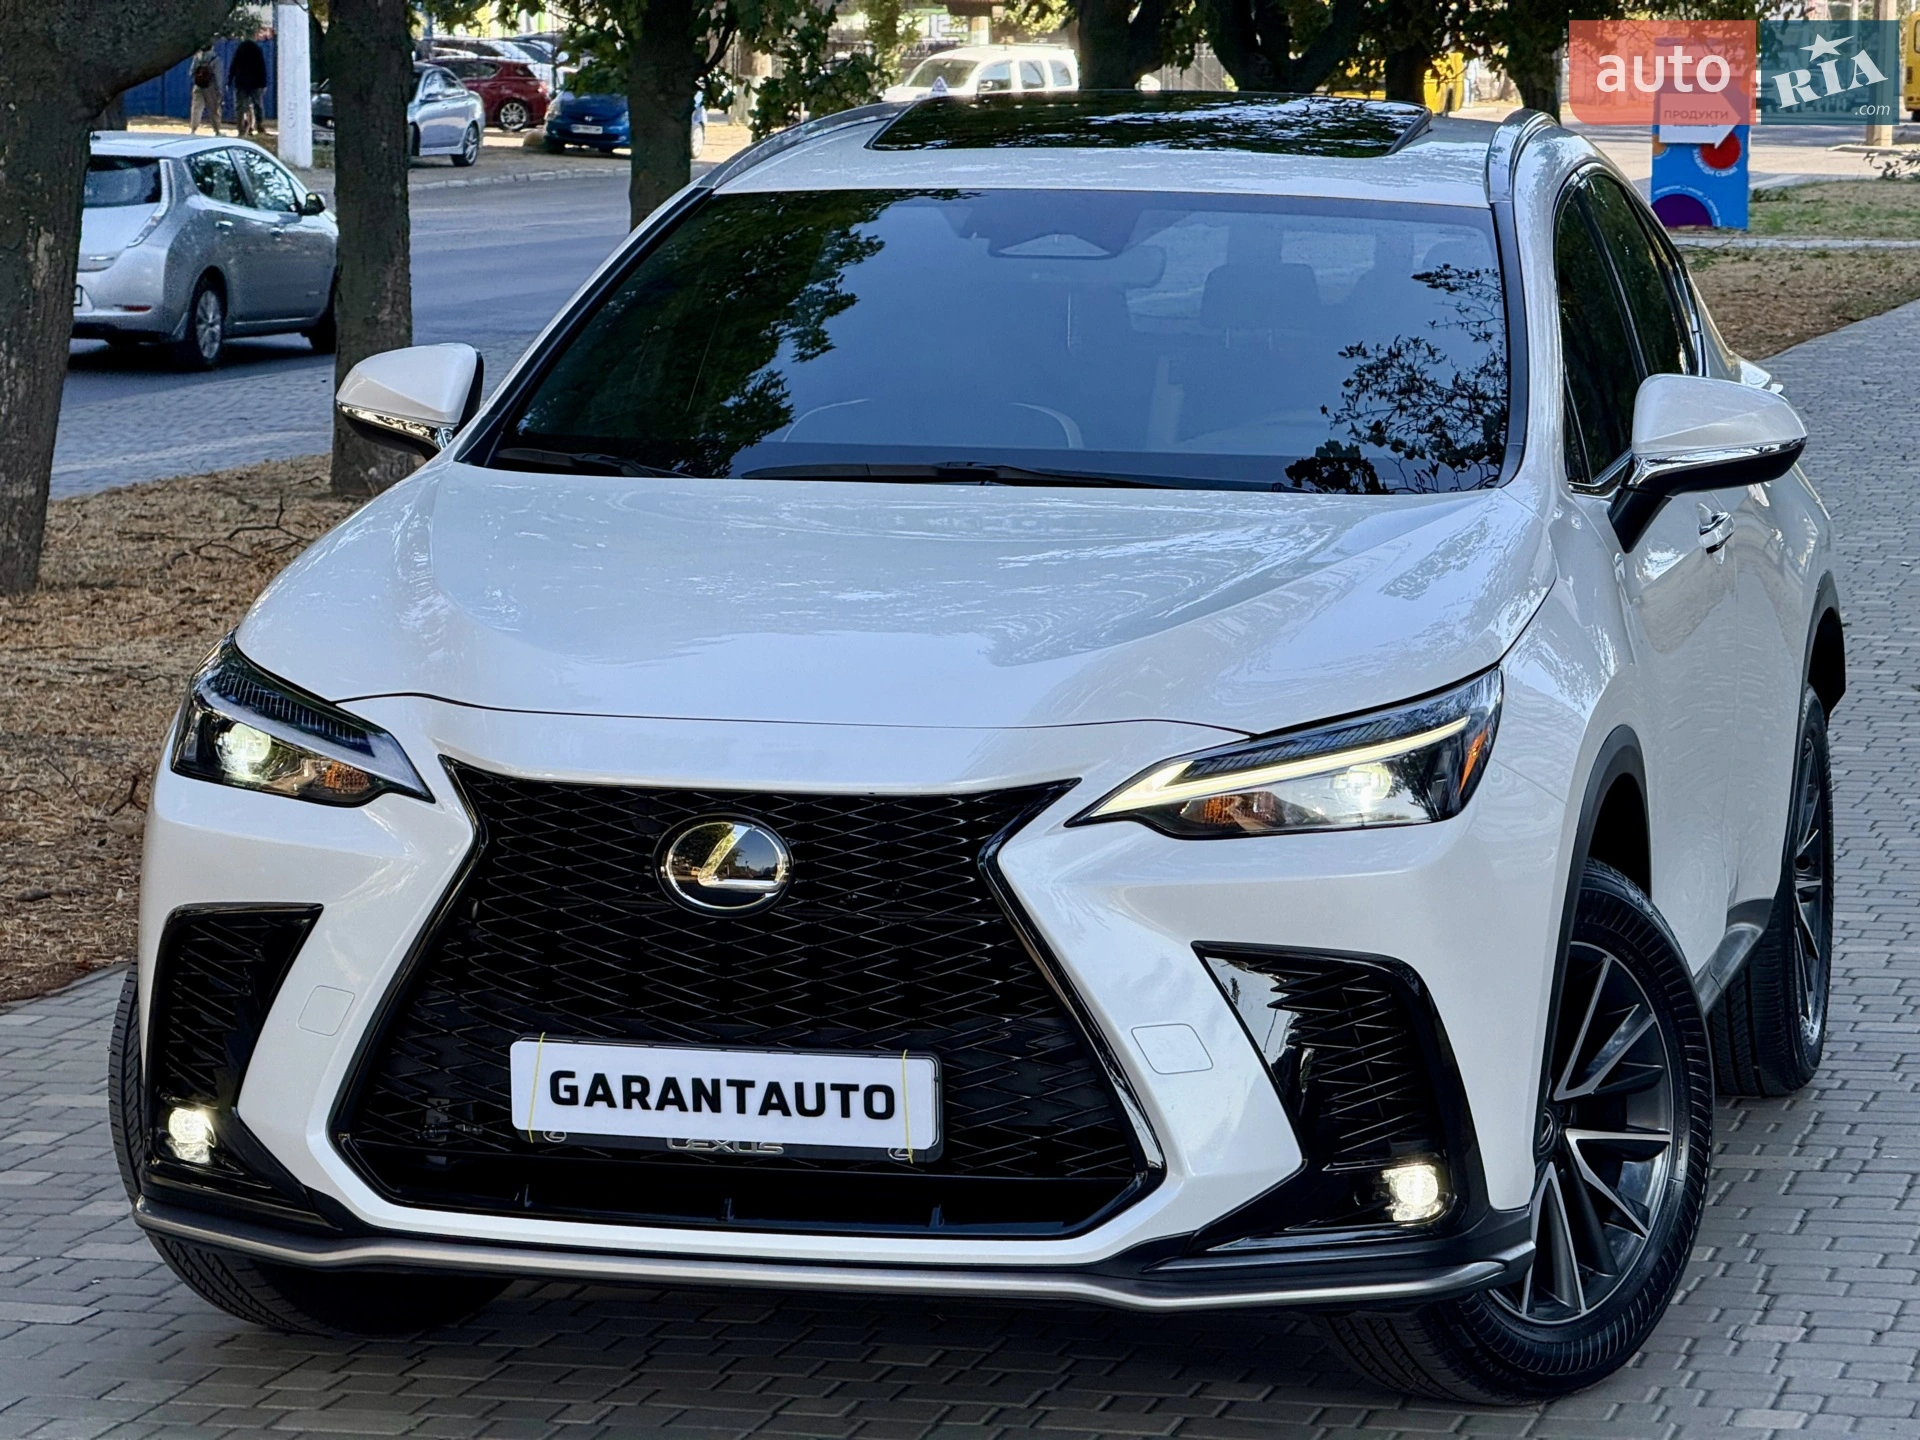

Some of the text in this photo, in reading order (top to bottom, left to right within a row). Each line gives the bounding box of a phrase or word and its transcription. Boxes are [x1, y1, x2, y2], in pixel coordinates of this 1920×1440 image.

[1664, 110, 1729, 120] ПРОДУКТИ
[549, 1069, 895, 1121] GARANTAUTO
[666, 1137, 784, 1155] LEXUS
